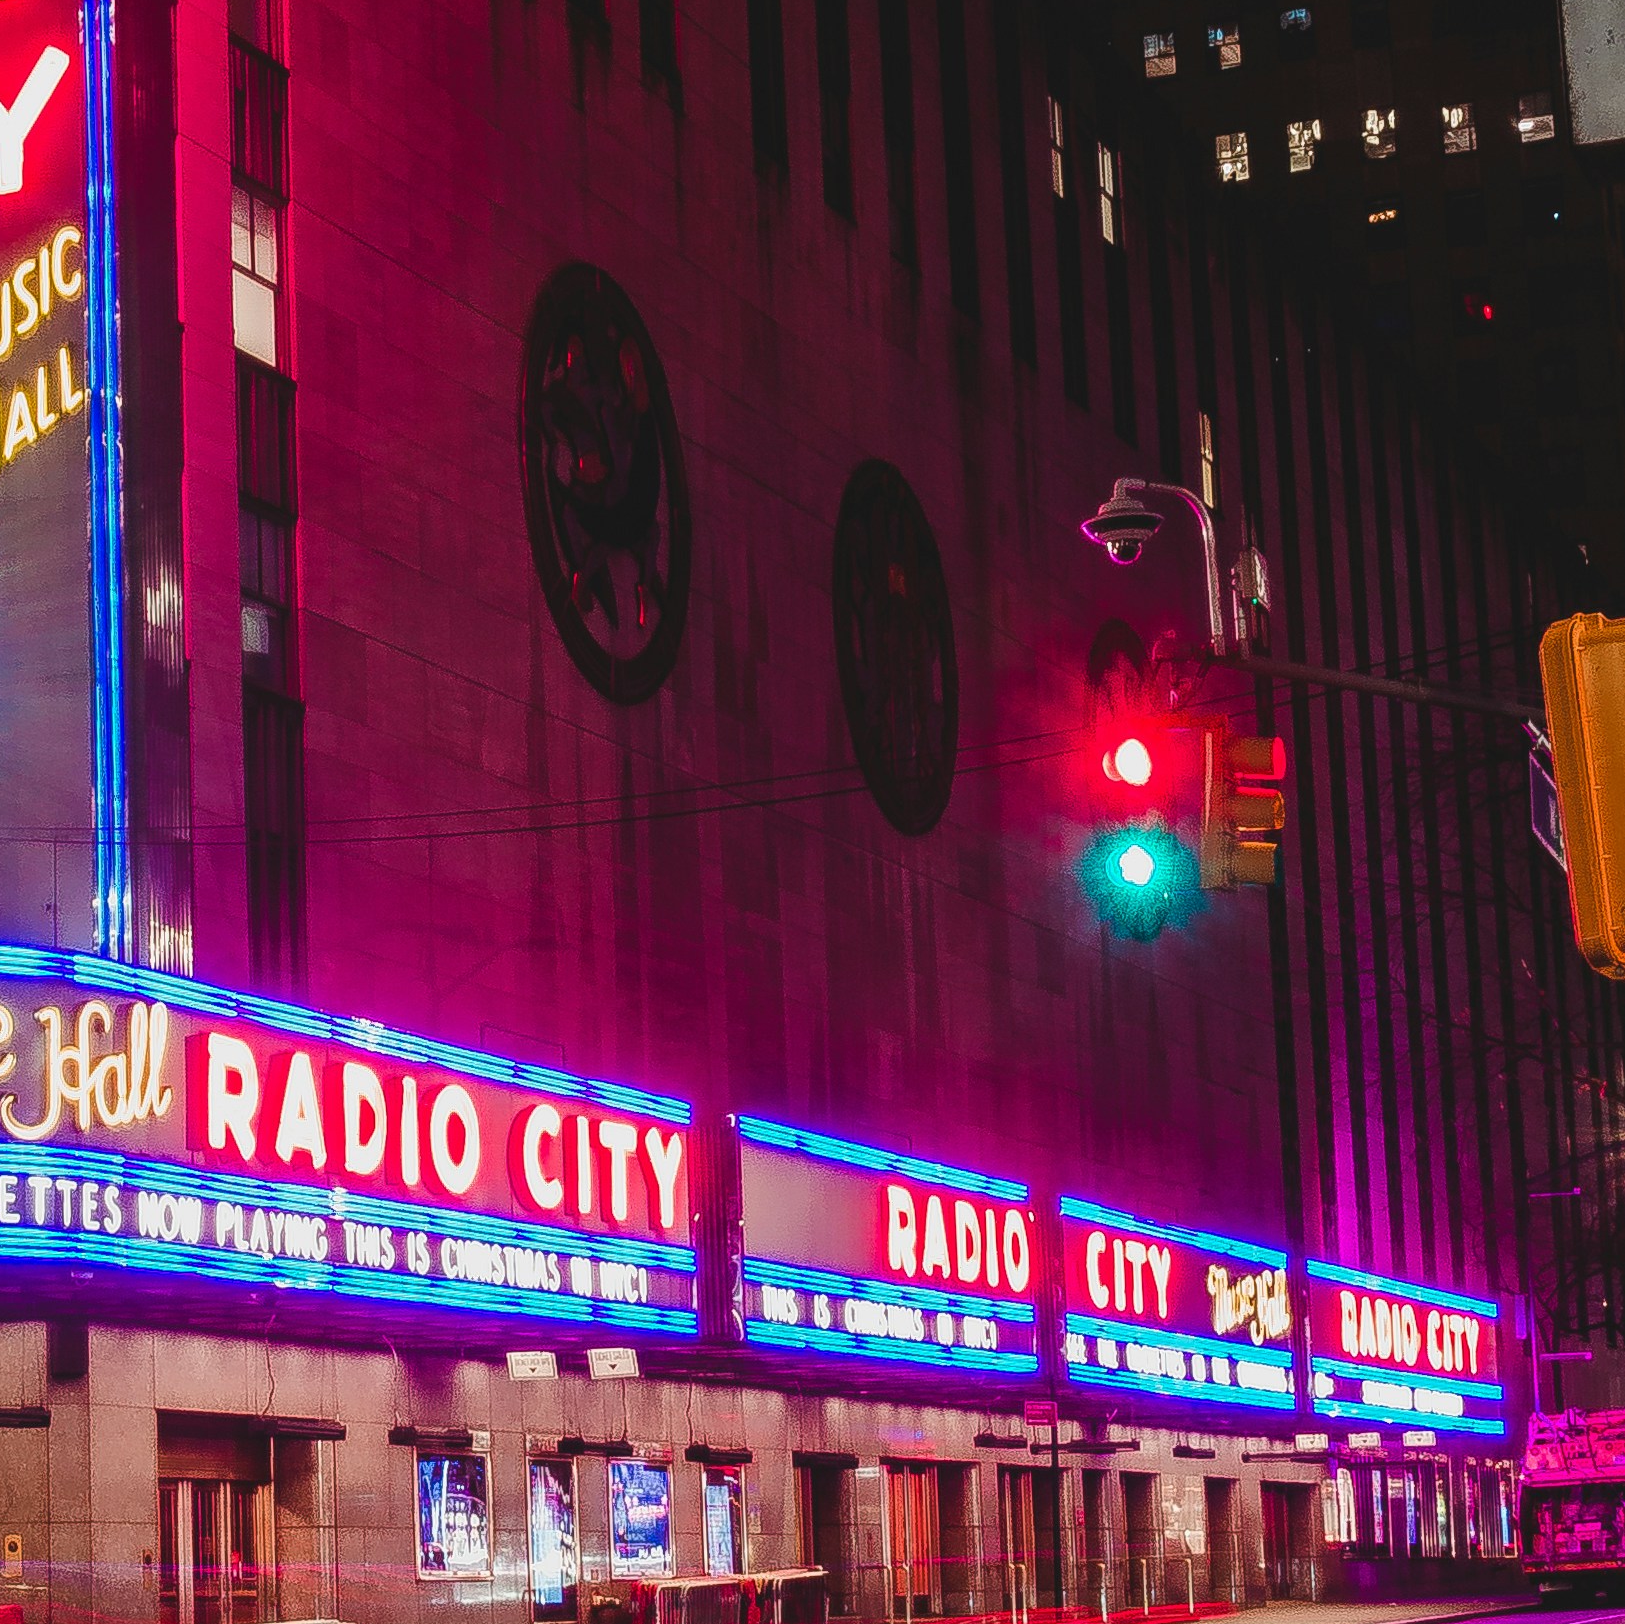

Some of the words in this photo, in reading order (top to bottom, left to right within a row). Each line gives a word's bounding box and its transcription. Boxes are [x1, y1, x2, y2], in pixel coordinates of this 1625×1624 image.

[207, 1032, 481, 1196] RADIO
[521, 1103, 683, 1230] CITY
[137, 1190, 203, 1244] NOW
[215, 1201, 328, 1261] PLAYING
[343, 1221, 395, 1270] THIS
[406, 1230, 431, 1275] IS
[886, 1185, 1032, 1294] RADIO
[1086, 1231, 1171, 1319] CITY
[1340, 1290, 1421, 1366] RADIO
[1427, 1309, 1479, 1375] CITY
